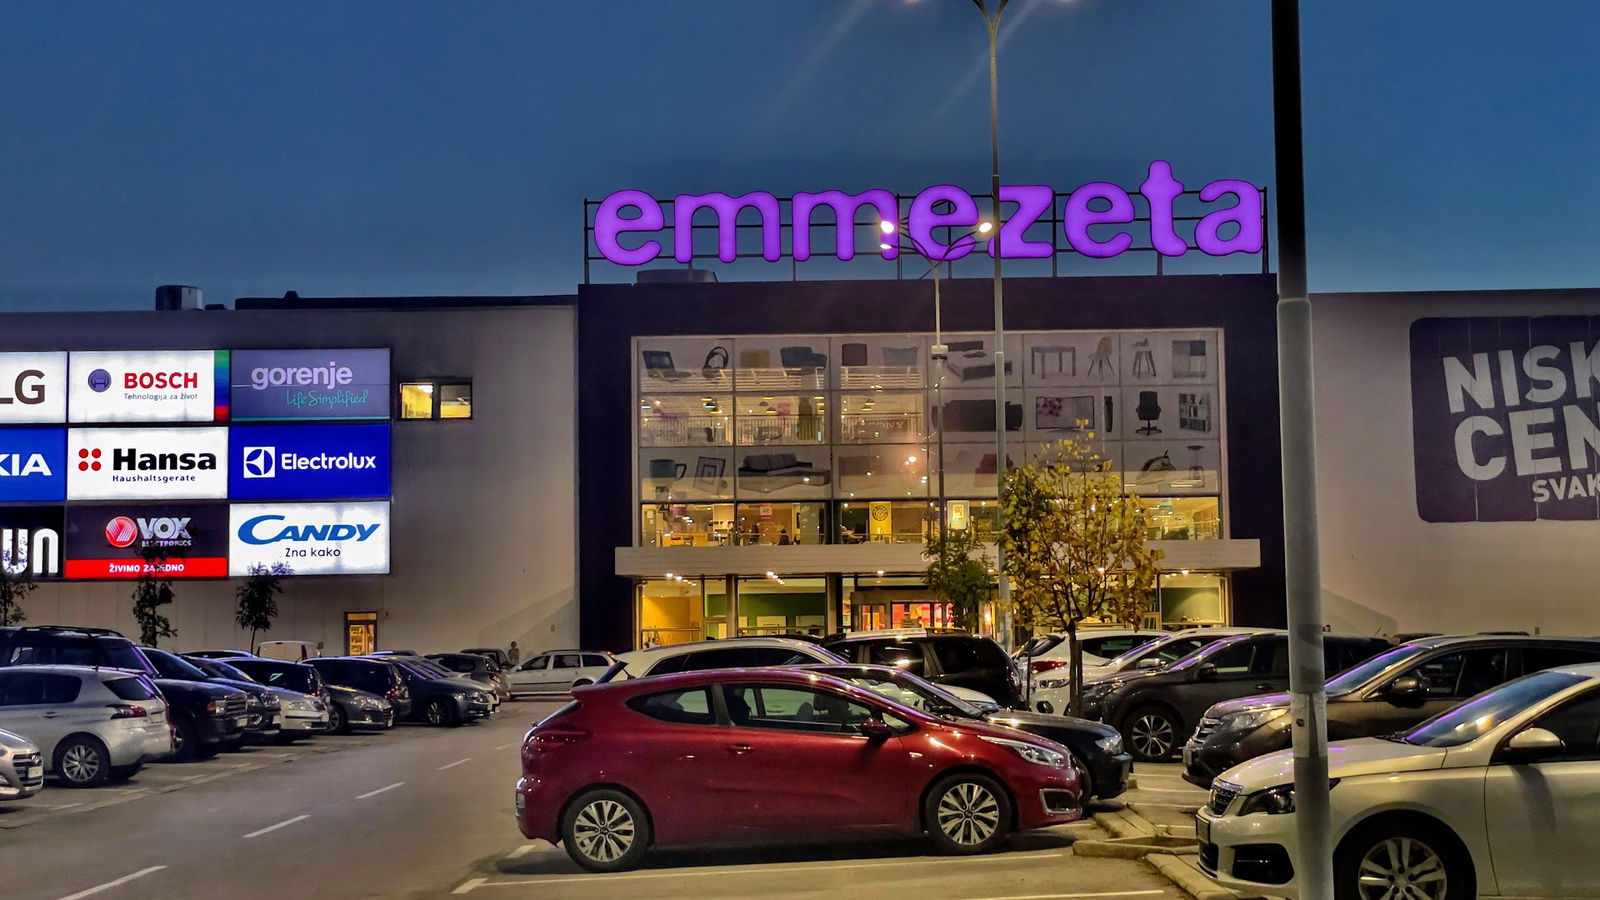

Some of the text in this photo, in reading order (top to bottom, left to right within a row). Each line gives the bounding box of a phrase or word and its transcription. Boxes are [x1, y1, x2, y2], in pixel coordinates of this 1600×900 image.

[594, 160, 1264, 266] emmezeta
[124, 372, 197, 389] BOSCH
[252, 361, 352, 390] gorenje
[1443, 341, 1600, 413] NISK
[124, 393, 167, 401] Tehnologija
[1455, 405, 1600, 480] CEN
[113, 448, 217, 470] Hansa
[281, 452, 376, 470] Electrolux
[112, 475, 196, 483] Haushaltsgerate
[1532, 473, 1600, 503] SVAK
[136, 517, 192, 540] VOX
[238, 514, 381, 545] CANDY
[285, 547, 341, 557] Zna kako
[109, 563, 141, 573] ŽIVIMO
